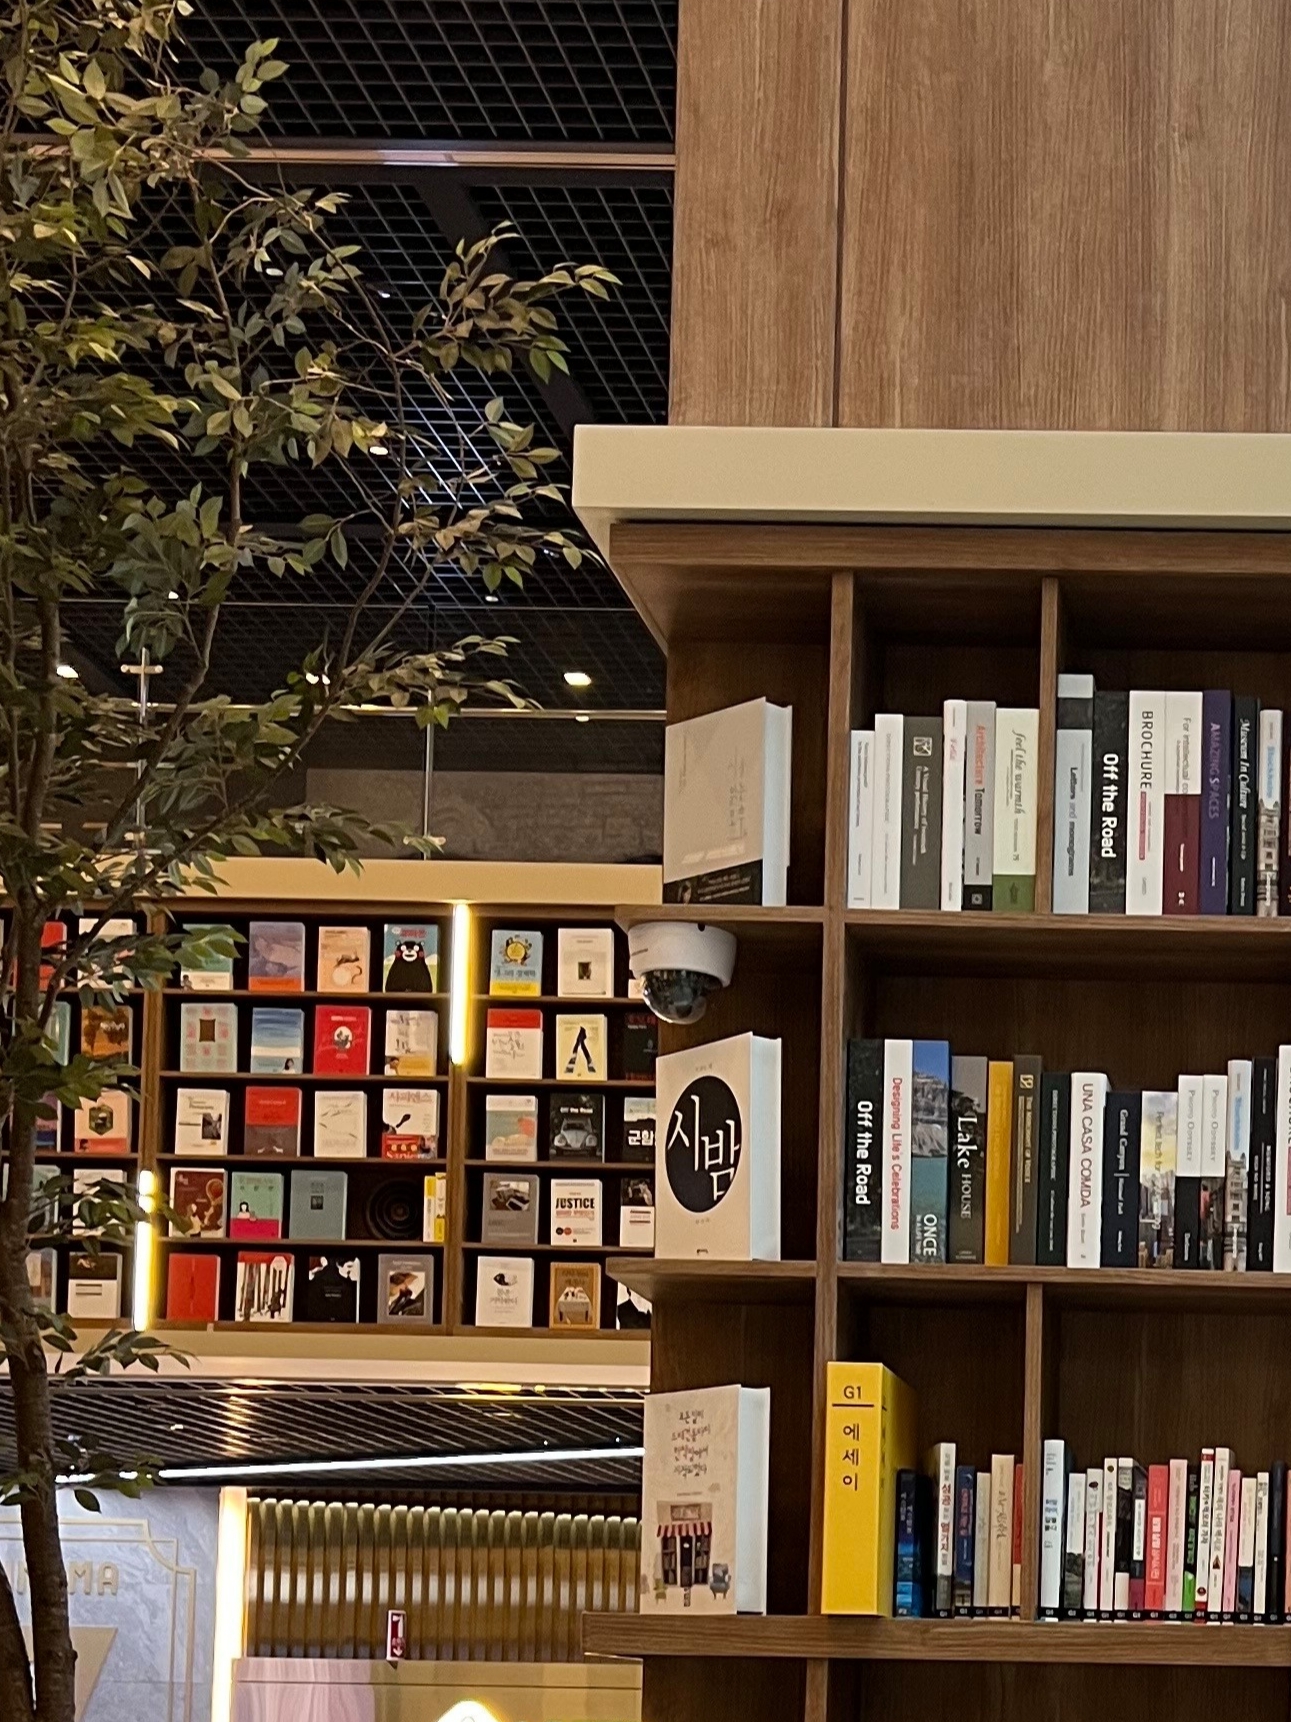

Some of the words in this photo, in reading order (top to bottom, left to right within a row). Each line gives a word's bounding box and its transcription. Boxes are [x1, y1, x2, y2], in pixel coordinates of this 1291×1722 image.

[1011, 730, 1027, 752] feel
[1182, 718, 1192, 731] For
[1239, 719, 1250, 759] Museum
[1014, 755, 1026, 770] the
[1103, 754, 1119, 779] Off
[1140, 711, 1154, 789] BROCHURE
[1209, 723, 1221, 776] AMAZING
[1239, 761, 1250, 772] In
[1013, 773, 1026, 815] warmth
[1102, 785, 1118, 812] the
[1208, 778, 1220, 819] SPACES
[1238, 774, 1250, 809] Culture
[973, 788, 986, 835] Tomorrow
[1101, 816, 1118, 858] Road
[857, 1101, 873, 1127] Off
[890, 1078, 903, 1129] Designing
[1081, 1083, 1094, 1112] UNA
[628, 1129, 655, 1147] 군함
[1080, 1117, 1093, 1153] CASA
[1119, 1109, 1129, 1136] Grand
[856, 1132, 872, 1158] the
[891, 1133, 903, 1160] Life's
[956, 1116, 978, 1169] Lake
[855, 1164, 871, 1205] Road
[890, 1164, 902, 1230] Celebrations
[960, 1173, 973, 1219] HOUSE
[555, 1197, 595, 1209] JUSTICE
[923, 1213, 937, 1256] ONCE
[843, 1385, 862, 1400] G1
[842, 1423, 860, 1491] 에세이
